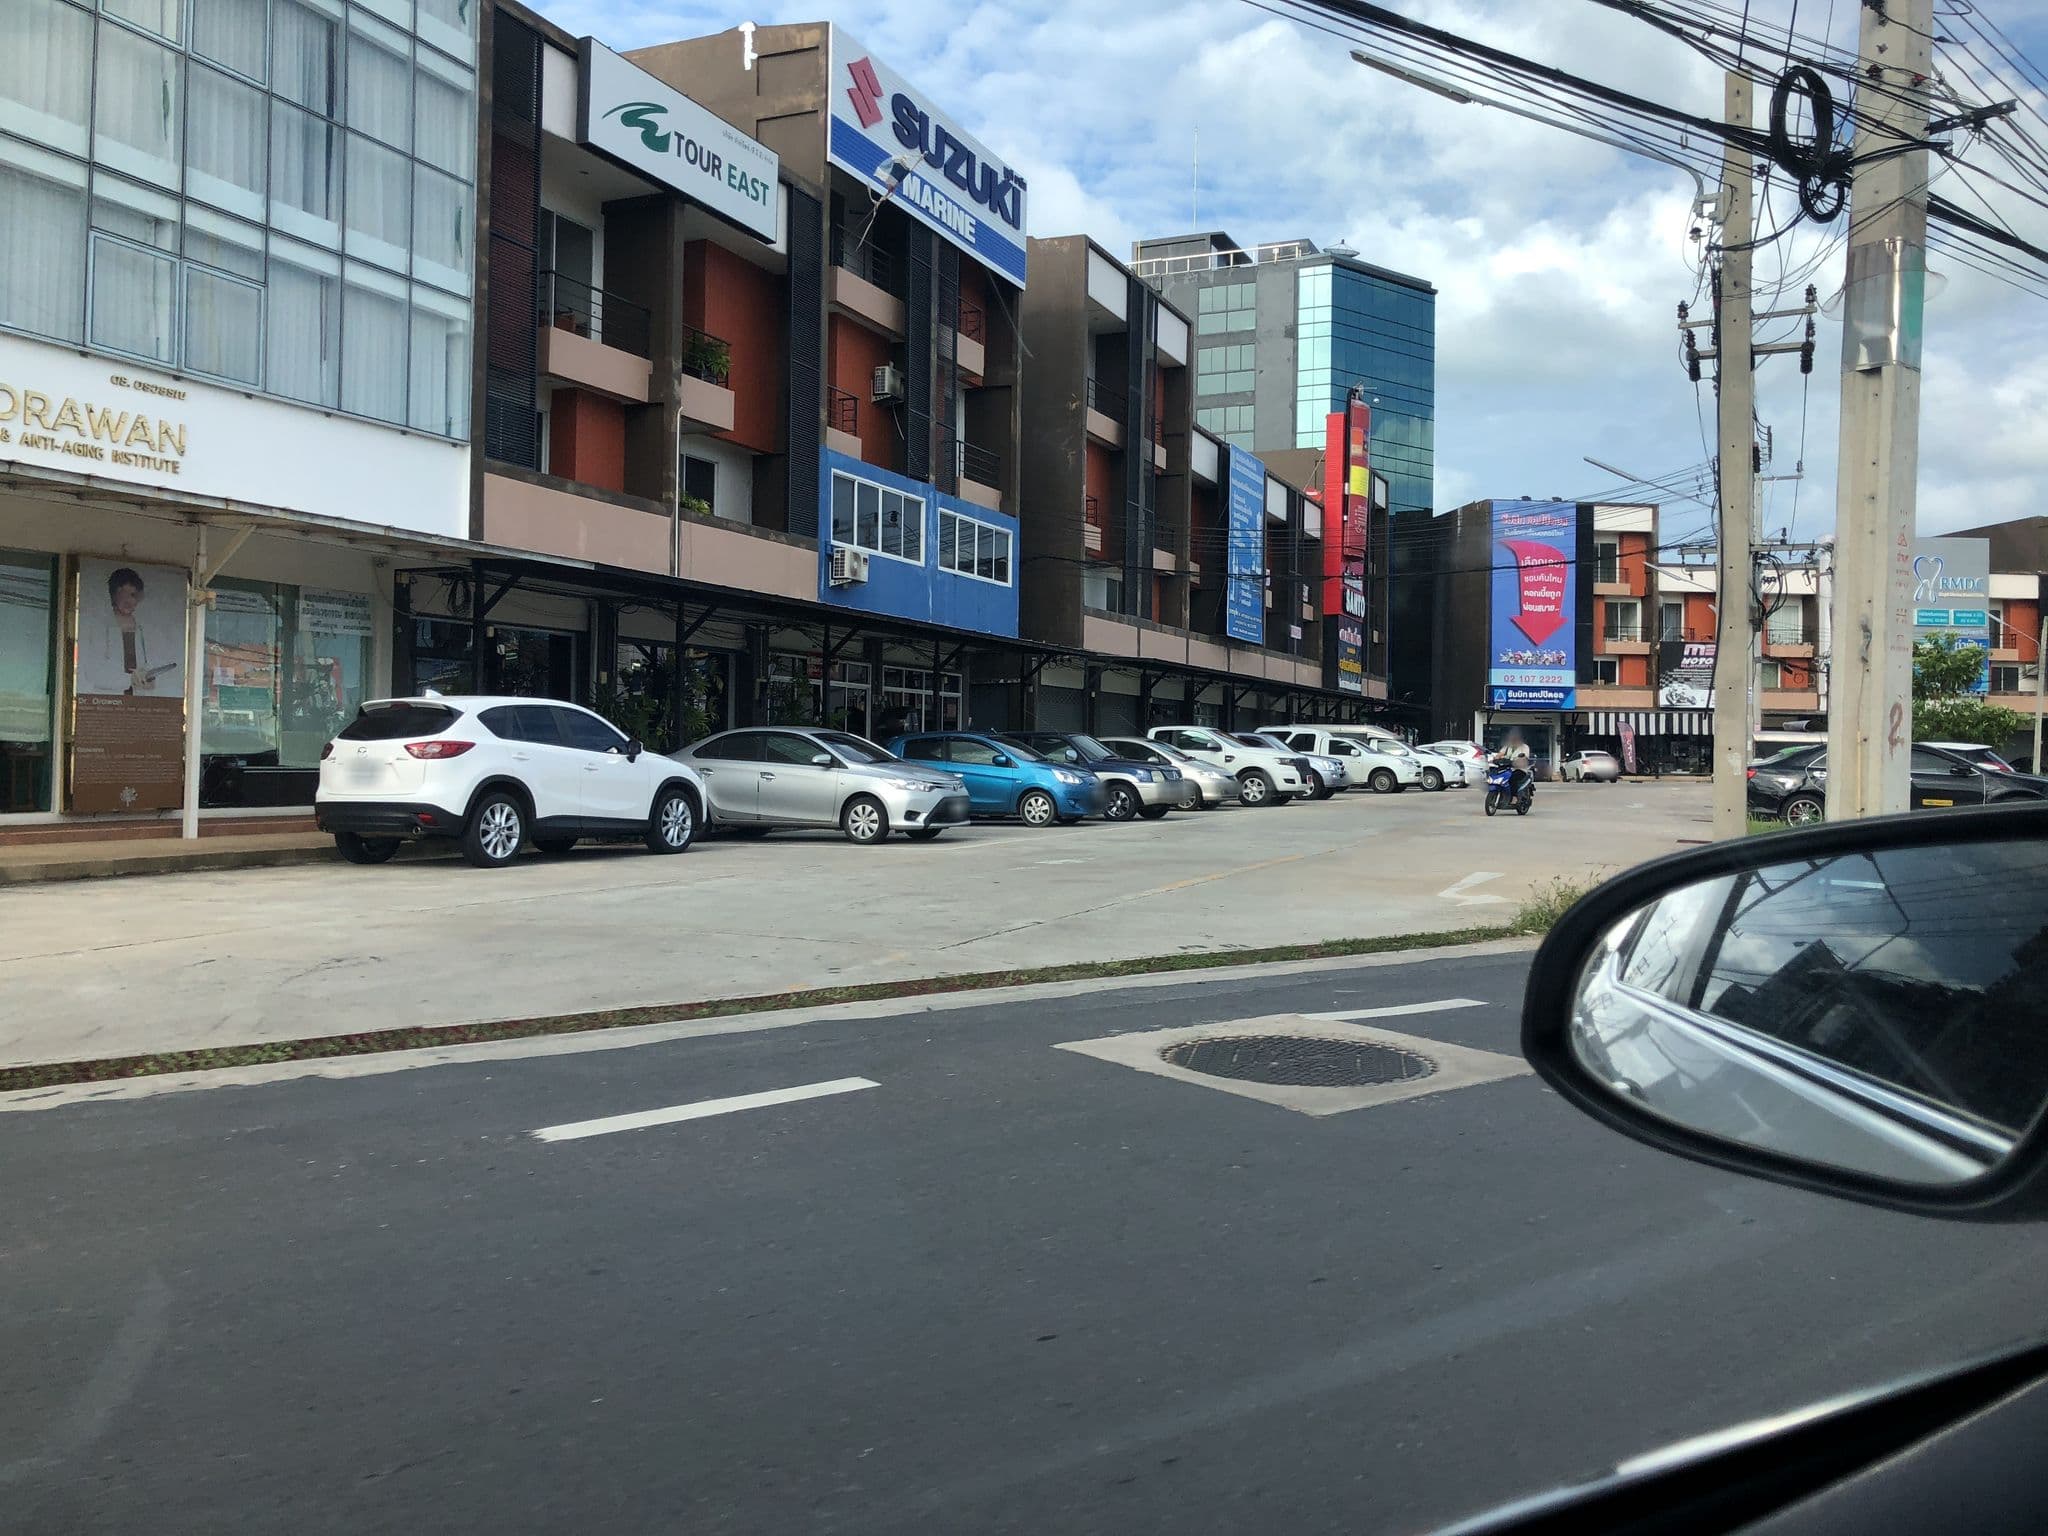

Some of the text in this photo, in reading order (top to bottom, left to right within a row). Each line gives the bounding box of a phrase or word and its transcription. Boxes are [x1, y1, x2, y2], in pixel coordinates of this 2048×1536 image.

[674, 130, 722, 181] TOUR
[728, 162, 770, 206] EAST
[891, 93, 1021, 230] SUZUKI
[903, 173, 976, 243] MARINE
[20, 432, 104, 462] ANTI-AGING
[111, 449, 181, 475] INSTITUTE
[1940, 576, 1984, 591] RMDC
[1503, 675, 1563, 684] 02 107 2222
